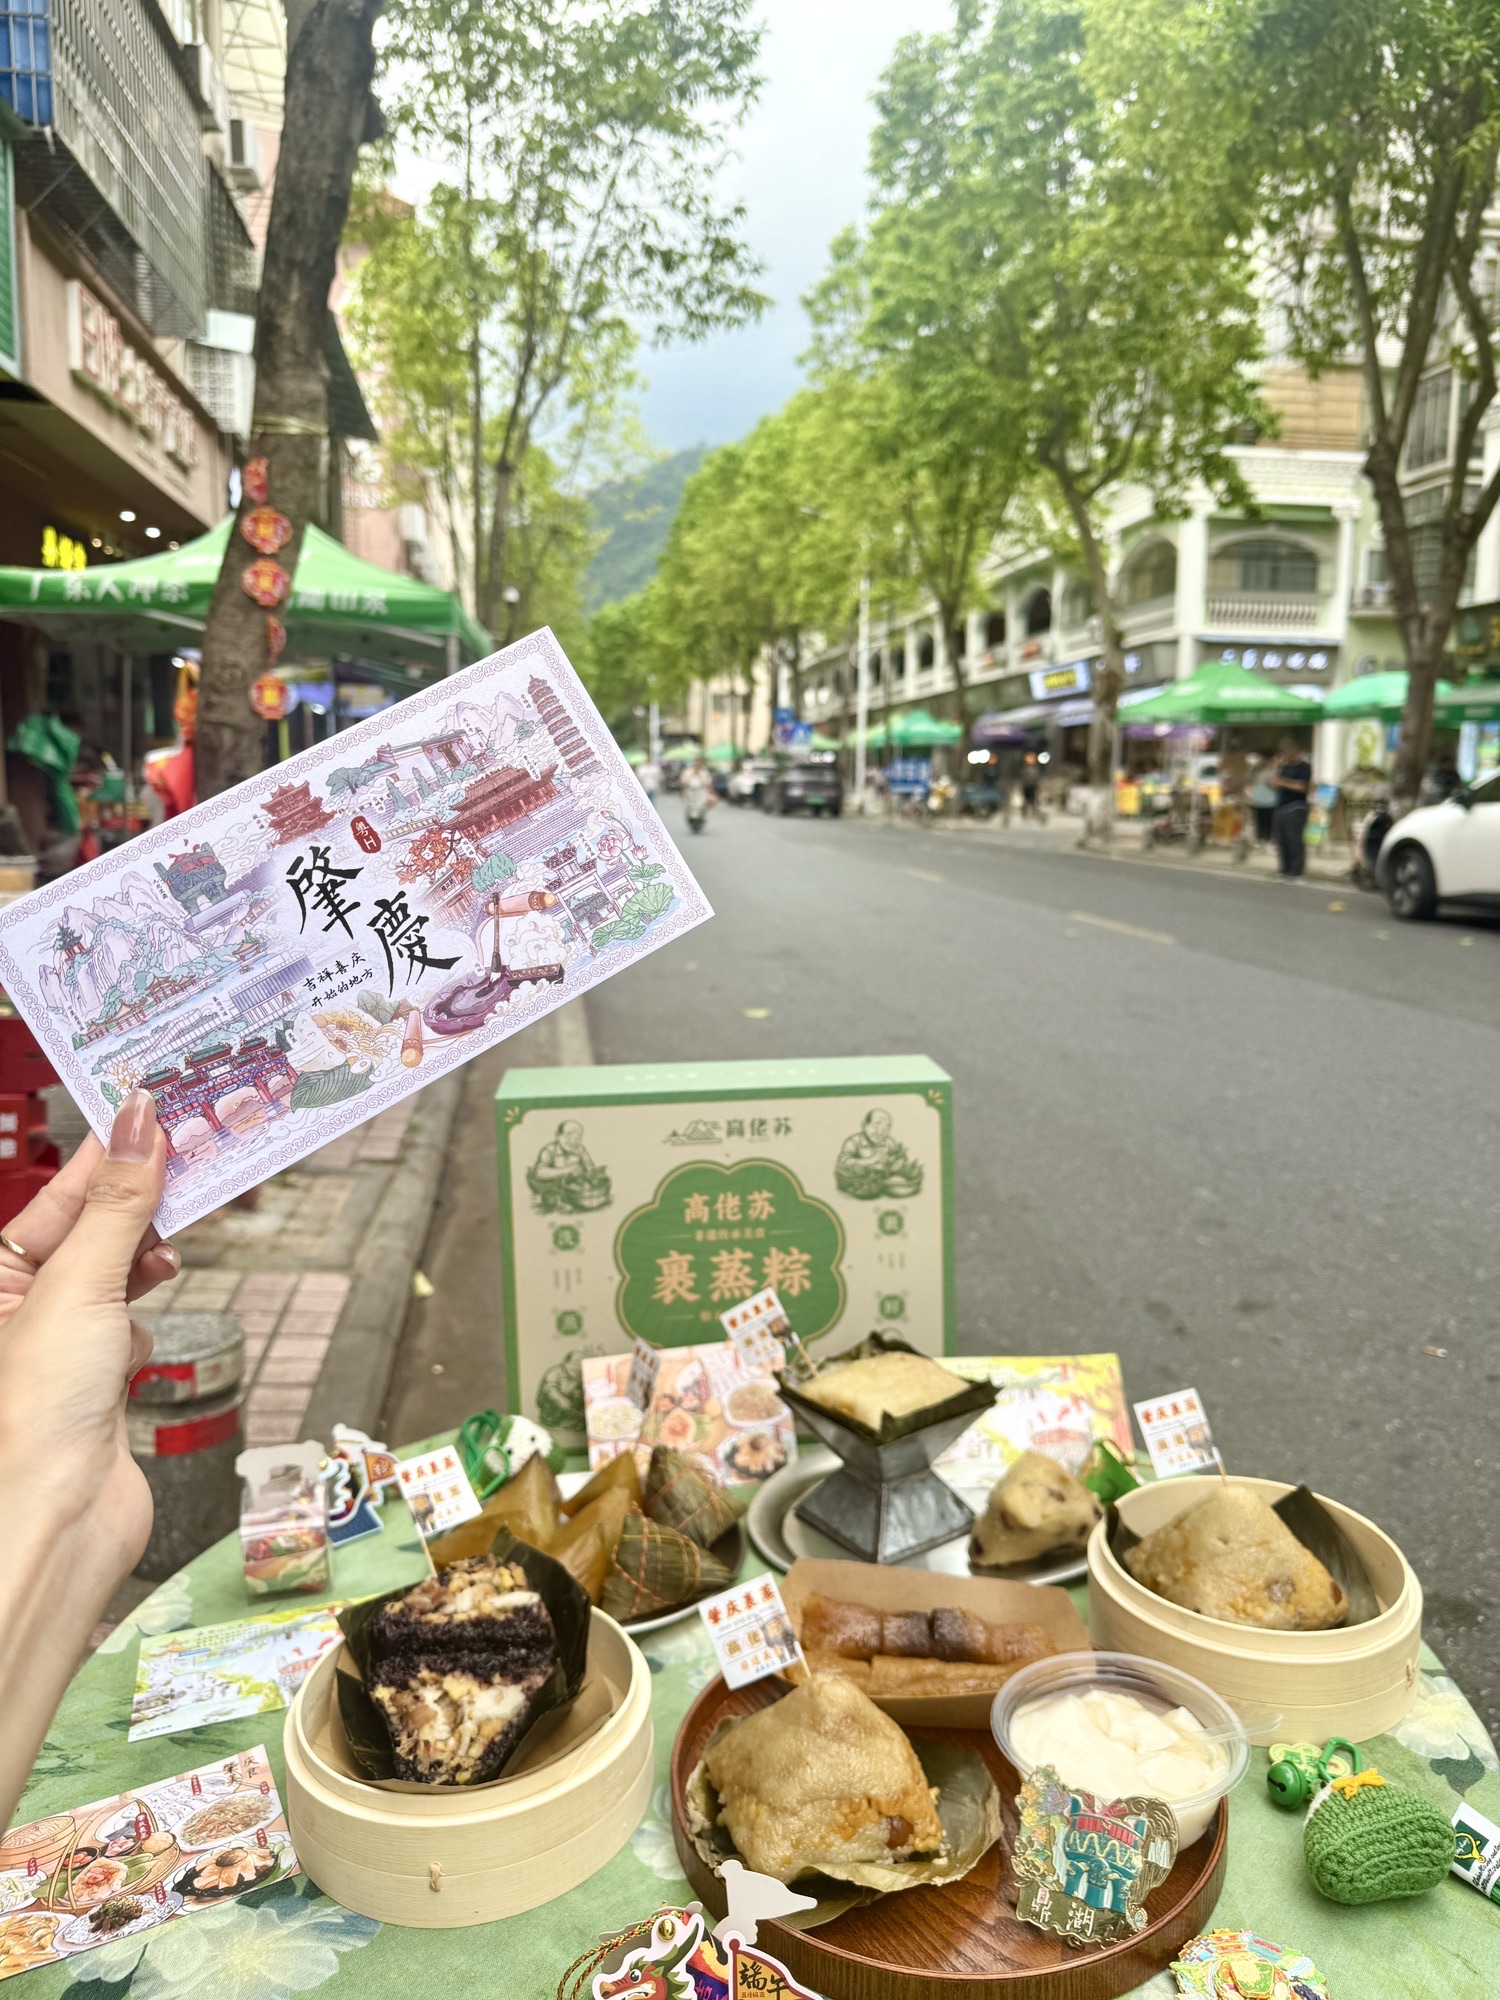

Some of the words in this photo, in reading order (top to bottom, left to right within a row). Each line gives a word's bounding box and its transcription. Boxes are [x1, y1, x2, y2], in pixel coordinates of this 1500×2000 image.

[355, 821, 377, 851] 粤H
[302, 951, 366, 992] 吉祥喜庆
[311, 967, 374, 1009] 开始的地方
[726, 1116, 792, 1138] 高佬苏
[683, 1189, 775, 1224] 高佬苏
[651, 1246, 812, 1305] 裹蒸粽
[1141, 1397, 1198, 1425] 肇庆裹蒸
[401, 1455, 456, 1483] 肇庆裹蒸
[708, 1583, 776, 1625] 肇庆裹蒸
[738, 1961, 790, 2000] 端午
